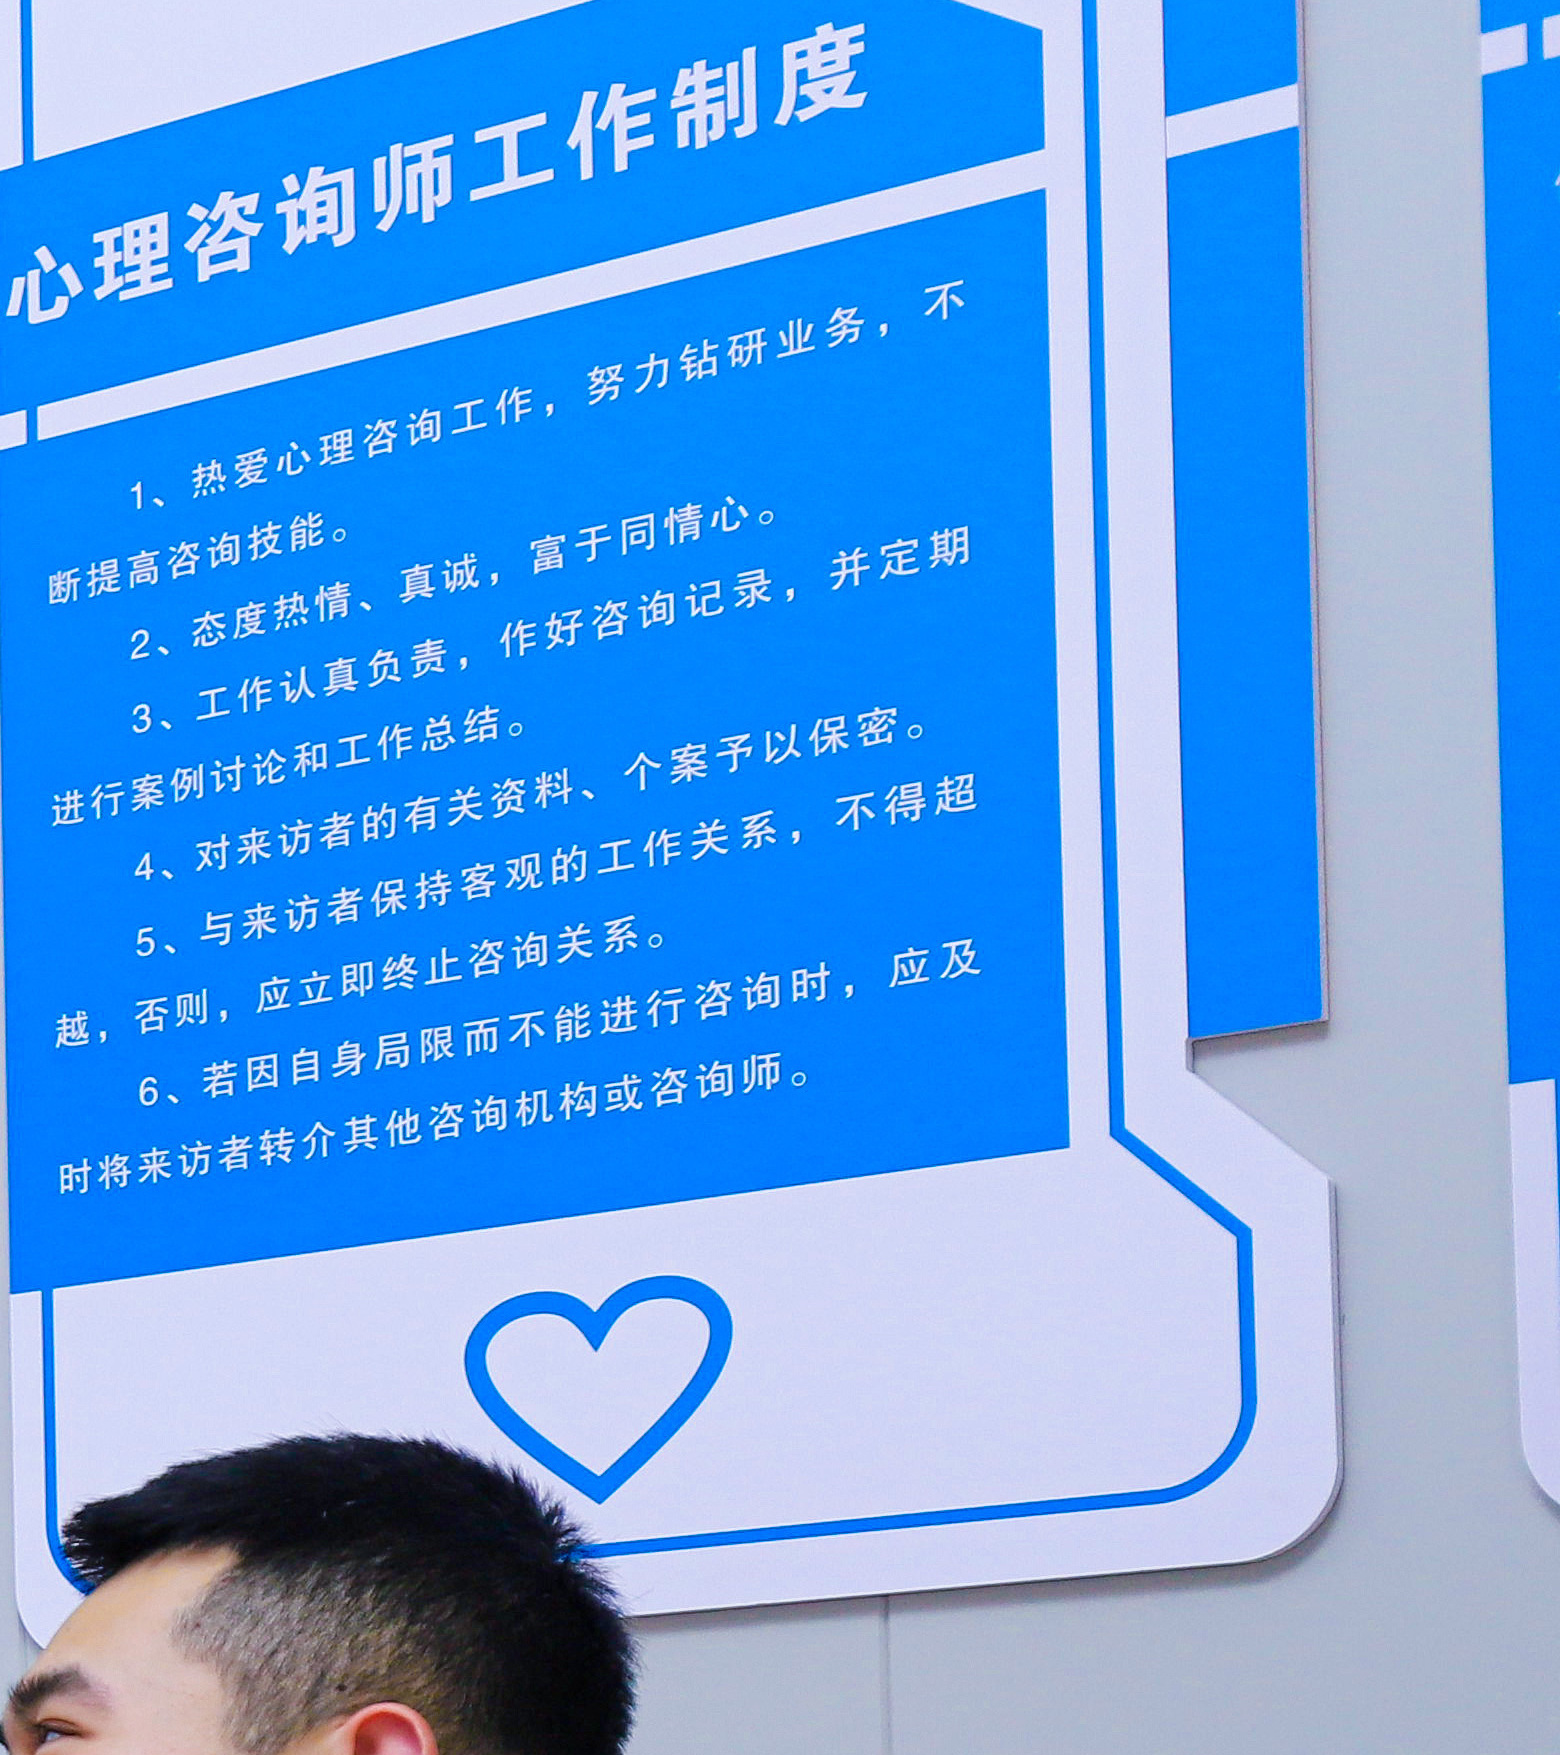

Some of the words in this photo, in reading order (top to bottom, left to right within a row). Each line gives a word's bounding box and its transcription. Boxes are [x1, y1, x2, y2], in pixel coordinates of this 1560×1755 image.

[5, 22, 868, 326] 心理咨询师工作制度
[129, 279, 965, 510] 1、热爱心理咨询工作，努力钻研业务，不
[48, 510, 352, 606] 断提高咨询技能。
[129, 495, 775, 661] 2、态度热情、真诚，富于同情心。
[131, 525, 970, 735] 3、工作认真负责，作好咨询记录，并定期
[50, 703, 526, 827] 进行案例讨论和工作总结。
[133, 705, 925, 882] 4、对来访者的有关资料、个案予以保密。
[135, 772, 978, 958] 5、与来访者保持客观的工作关系，不得超
[54, 914, 664, 1049] 越，否则，应立即终止咨询关系。
[138, 937, 982, 1107] 6、若因自身局限而不能进行咨询时，应及
[58, 1051, 808, 1195] 时将来访者转介其他咨询机构或咨询师。
